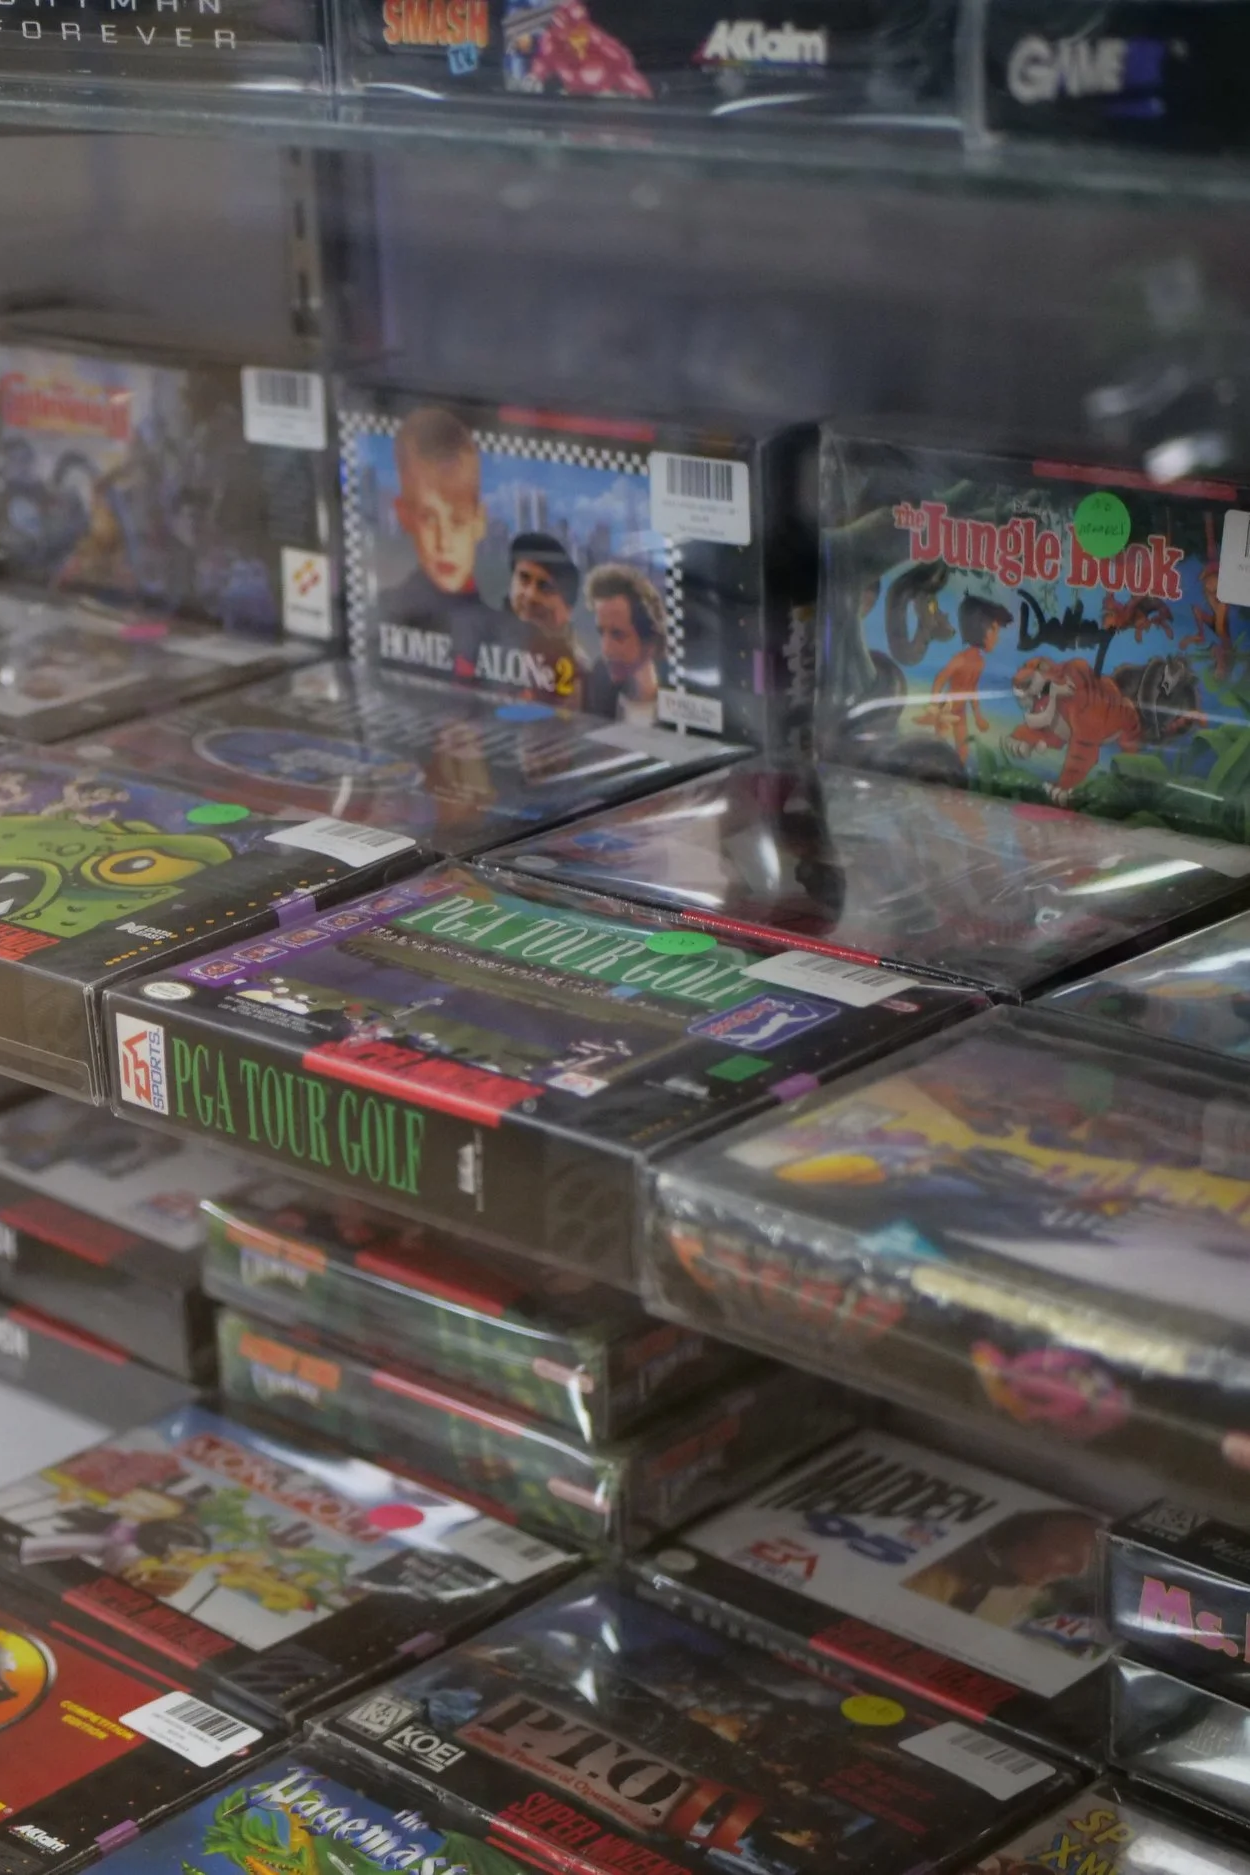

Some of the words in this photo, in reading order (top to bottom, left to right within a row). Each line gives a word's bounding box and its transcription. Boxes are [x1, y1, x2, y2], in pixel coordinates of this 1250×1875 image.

[382, 0, 490, 48] SMASH
[894, 502, 926, 530] The
[910, 502, 1062, 588] Jungle
[1065, 523, 1185, 601] Book
[378, 622, 454, 672] HOME
[556, 655, 576, 695] 2
[401, 893, 521, 942] PGA
[492, 917, 647, 976] TOUR
[148, 1029, 165, 1111] SPORTS
[172, 1037, 236, 1136] PGA
[239, 1061, 332, 1168] TOUR
[337, 1089, 427, 1195] GOLF
[755, 1448, 999, 1524] MADDEN
[1138, 1575, 1239, 1658] Ms.
[388, 1724, 467, 1770] KOEI
[507, 1791, 601, 1849] SUPER
